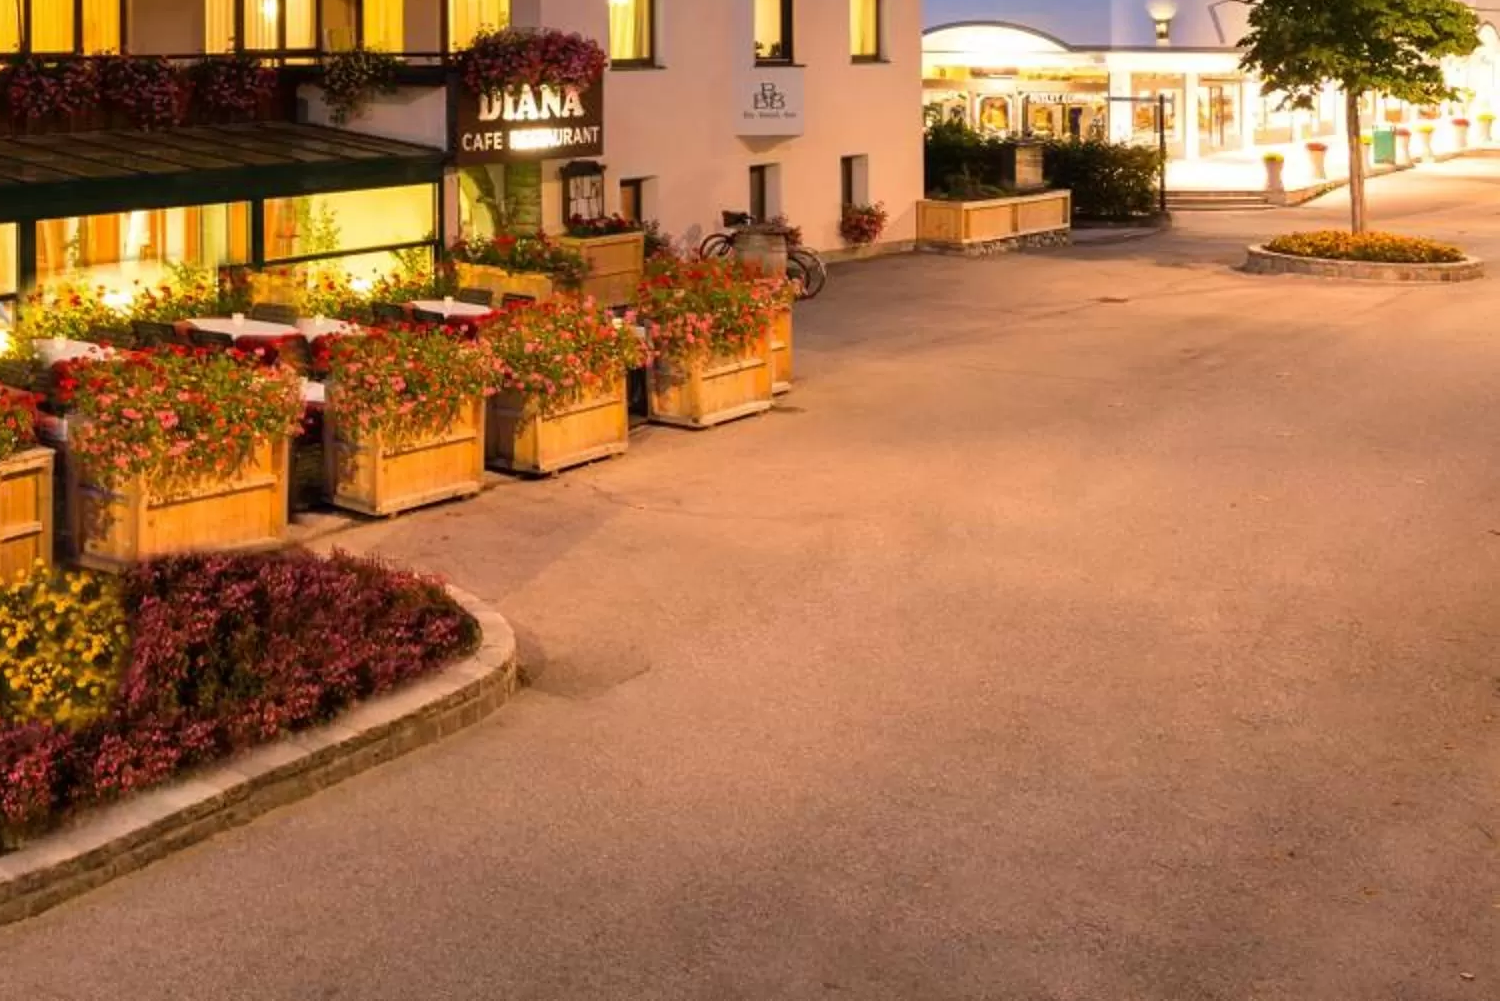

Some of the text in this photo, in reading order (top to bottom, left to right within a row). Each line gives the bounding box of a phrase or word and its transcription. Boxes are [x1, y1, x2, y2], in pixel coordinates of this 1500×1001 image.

[478, 84, 585, 121] DIANA
[462, 126, 600, 151] CAFE URANT
